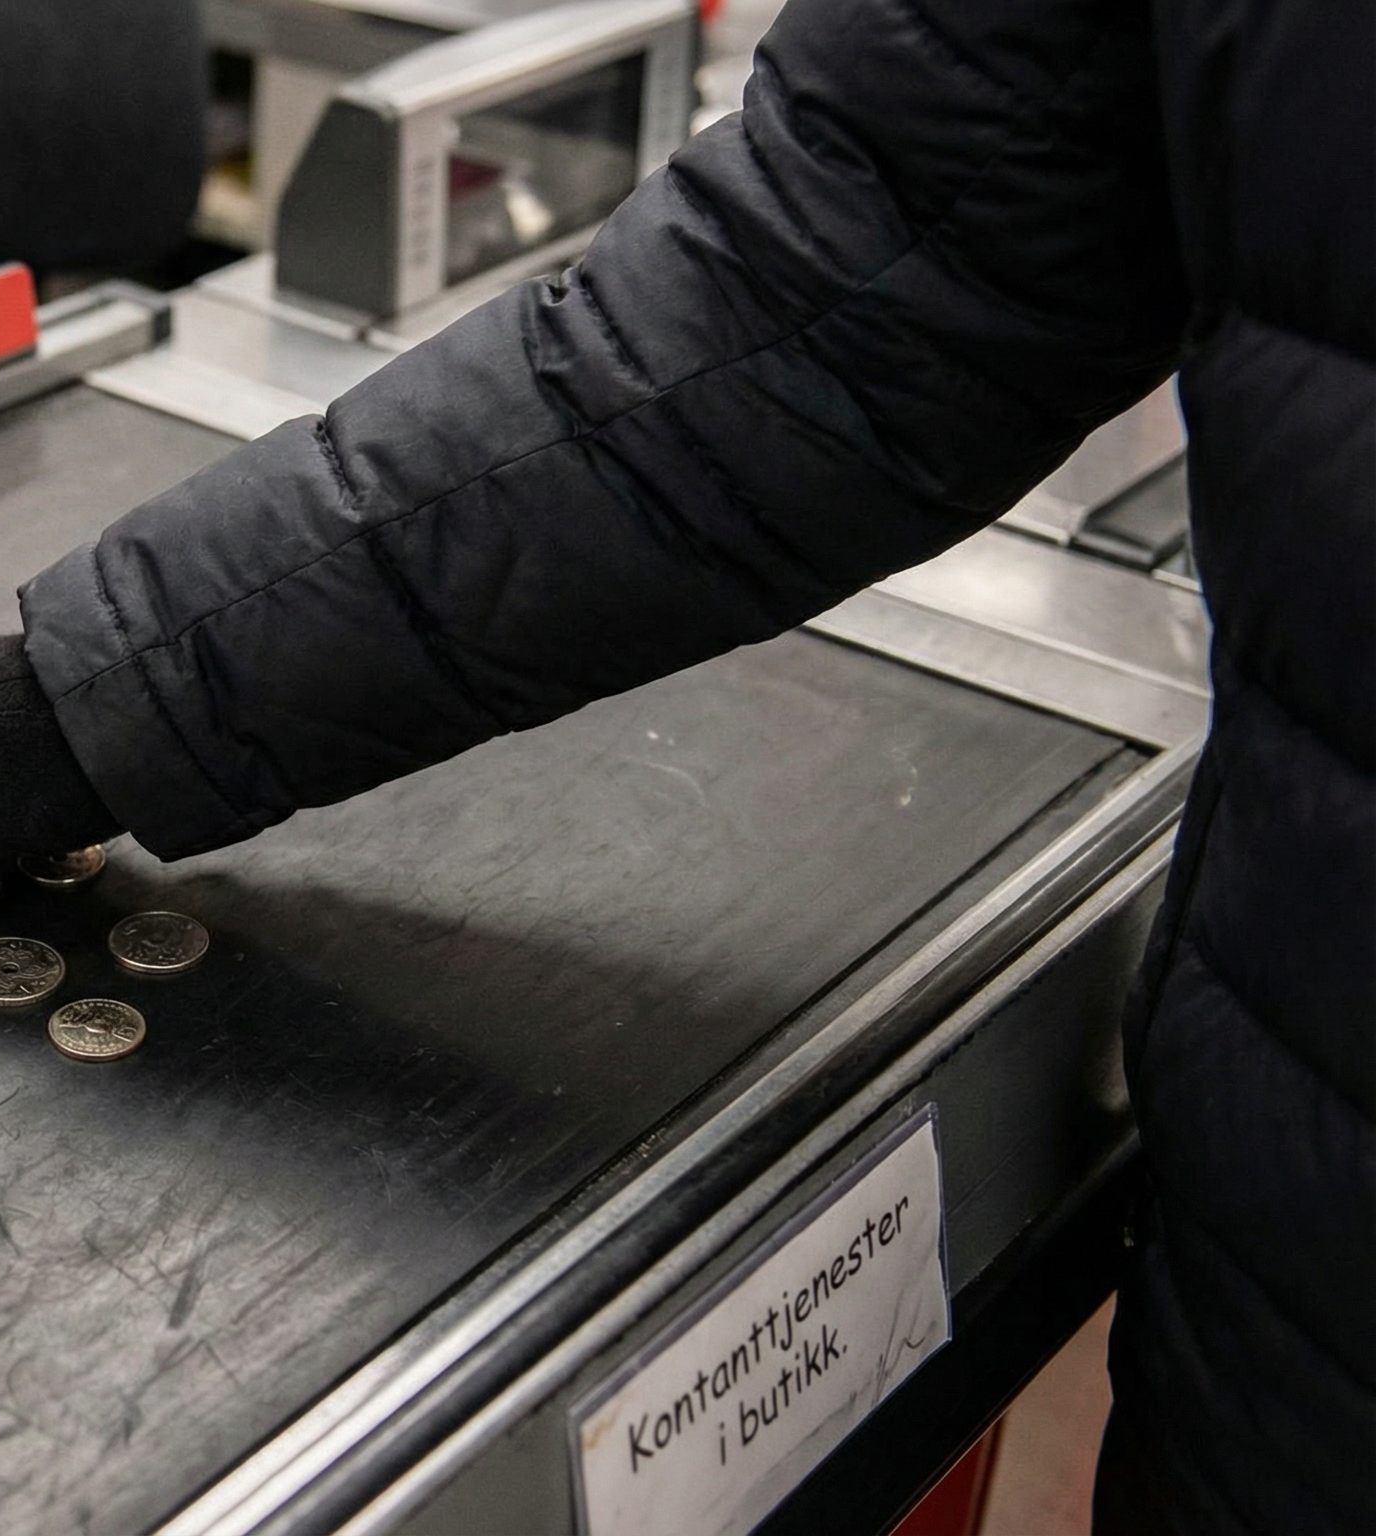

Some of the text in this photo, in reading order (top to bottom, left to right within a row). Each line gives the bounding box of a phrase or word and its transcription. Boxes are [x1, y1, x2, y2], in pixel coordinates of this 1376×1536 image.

[628, 1196, 908, 1473] Kontanttjenester
[718, 1422, 728, 1466] i
[740, 1325, 848, 1447] butikk.
